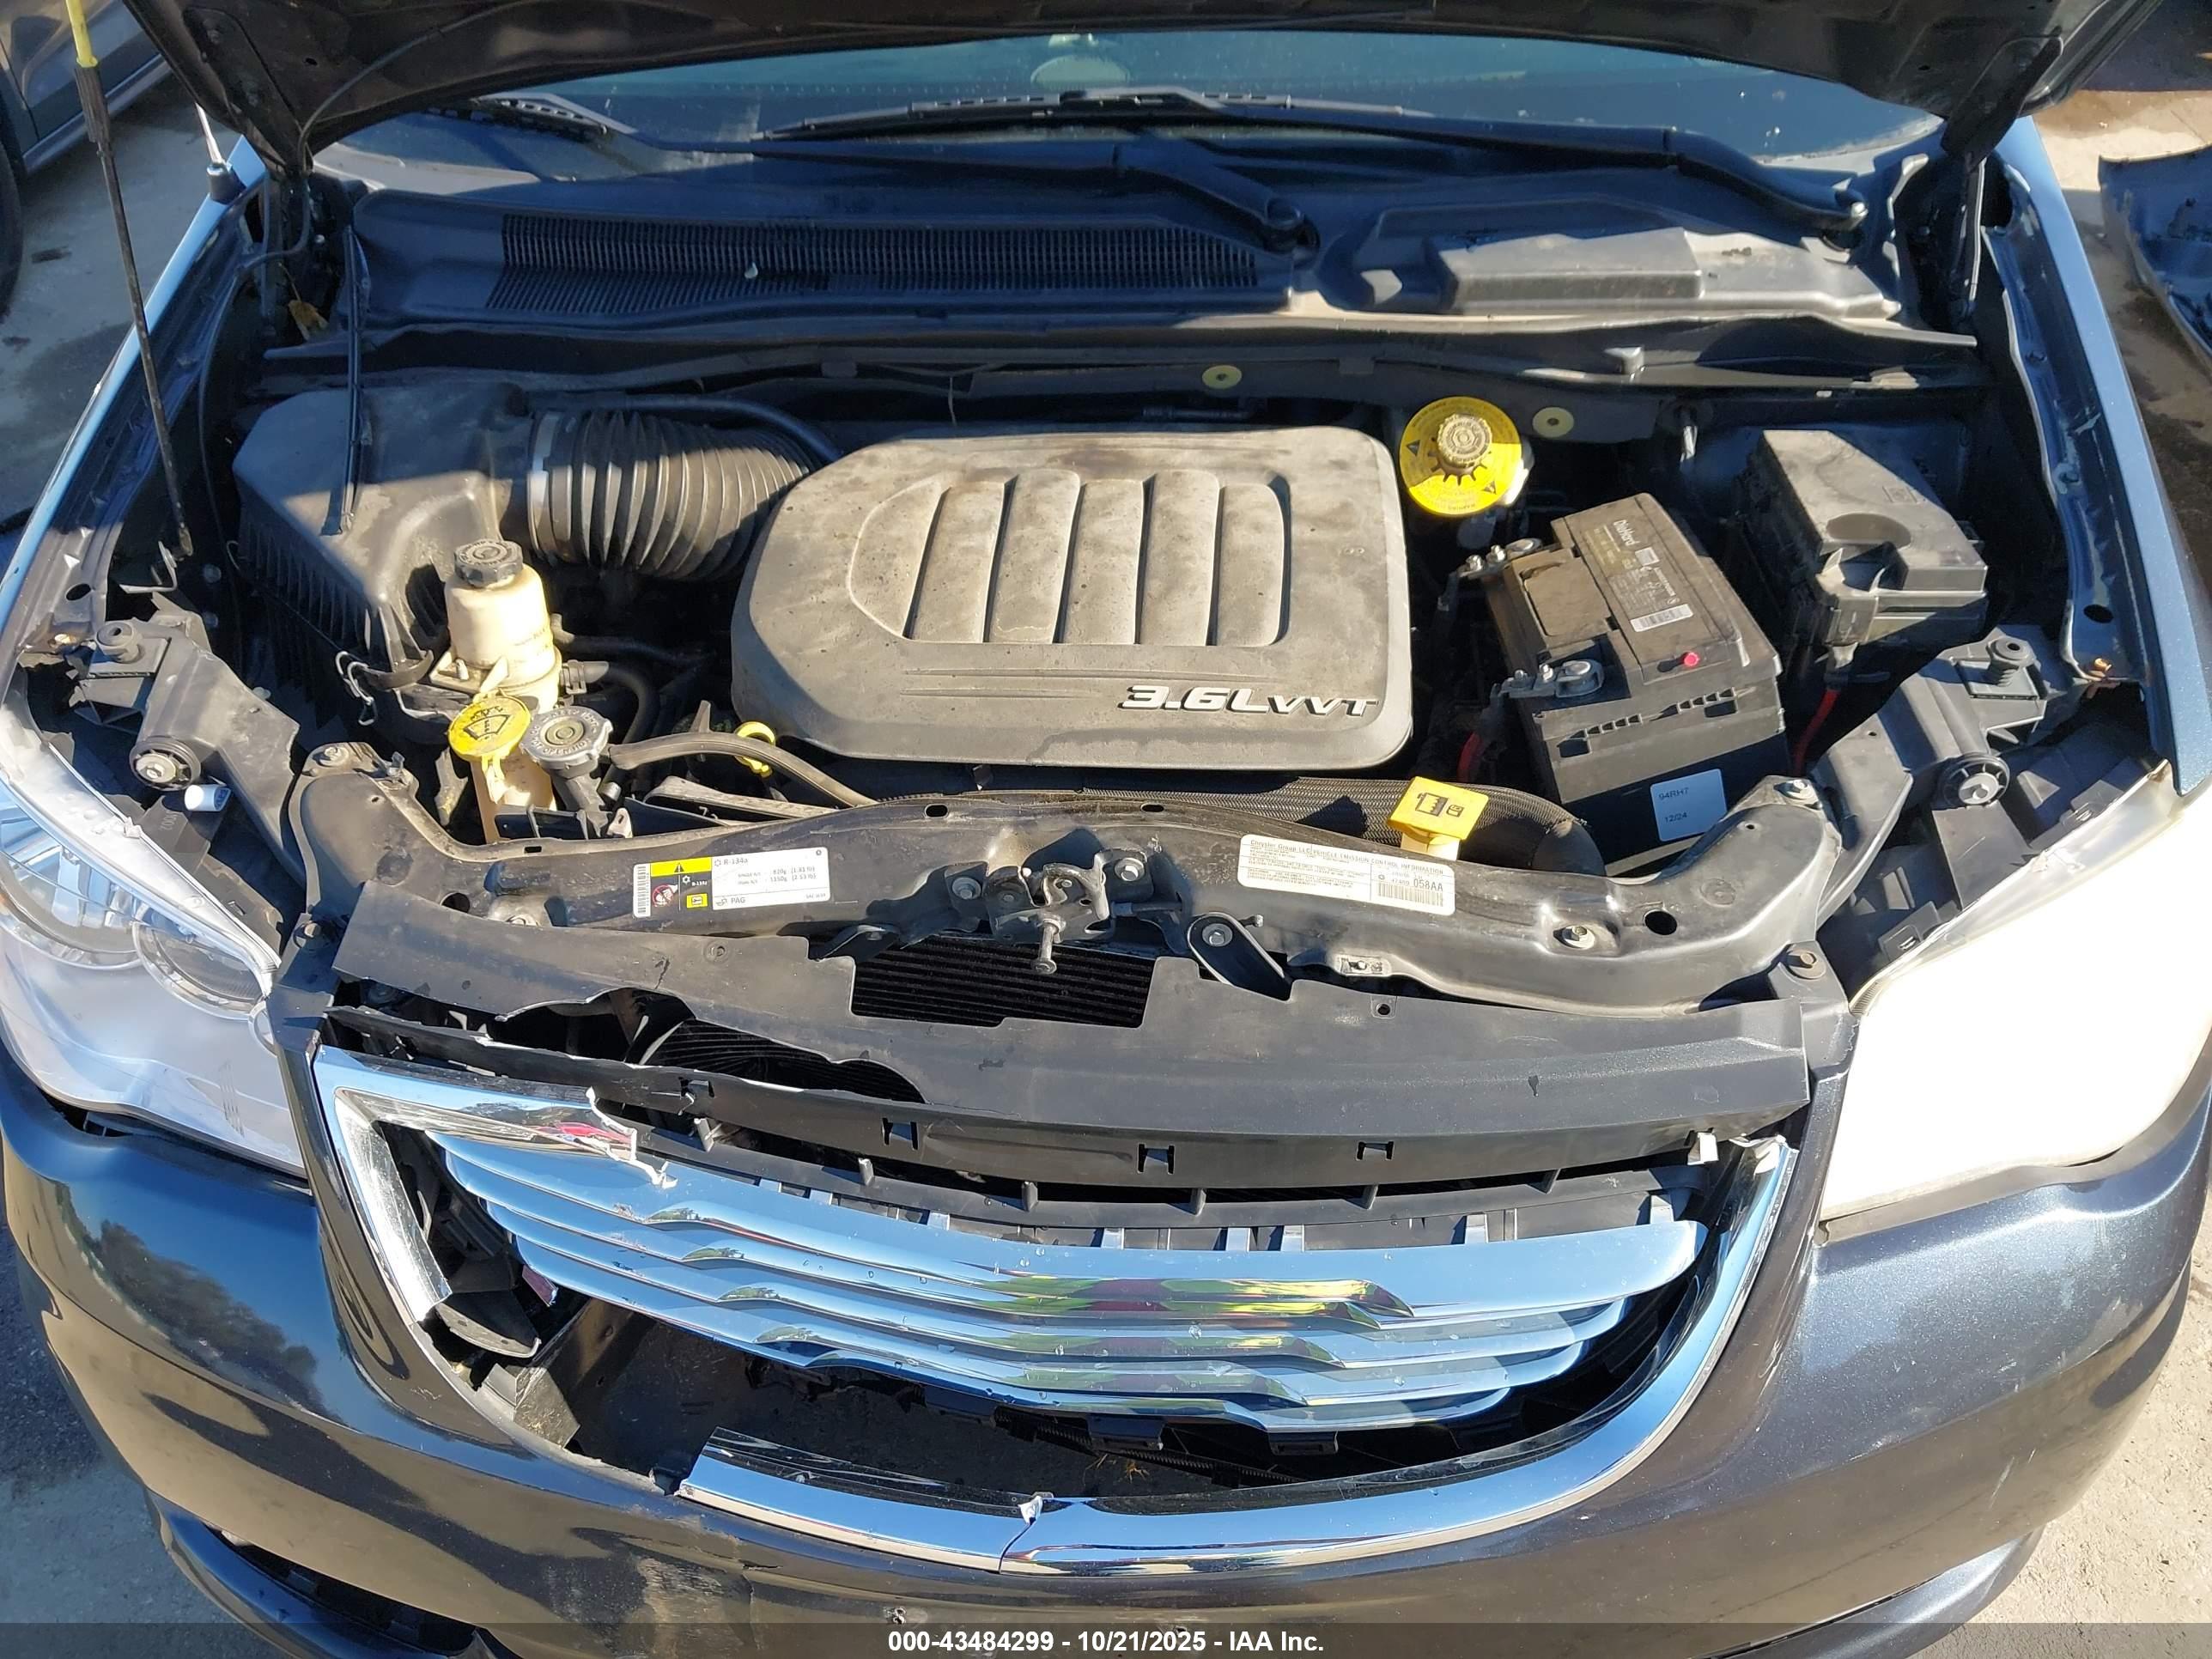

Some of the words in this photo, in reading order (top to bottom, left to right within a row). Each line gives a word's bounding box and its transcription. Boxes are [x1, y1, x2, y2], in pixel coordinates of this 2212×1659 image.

[1613, 520, 1641, 546] DieHard
[1664, 811, 1688, 823] 12/24
[1250, 840, 1276, 848] Chrysler
[1340, 853, 1370, 863] EMISSION
[1370, 858, 1398, 868] CONTROL
[1401, 863, 1443, 875] INFORMATION
[1413, 878, 1443, 891] 058AA
